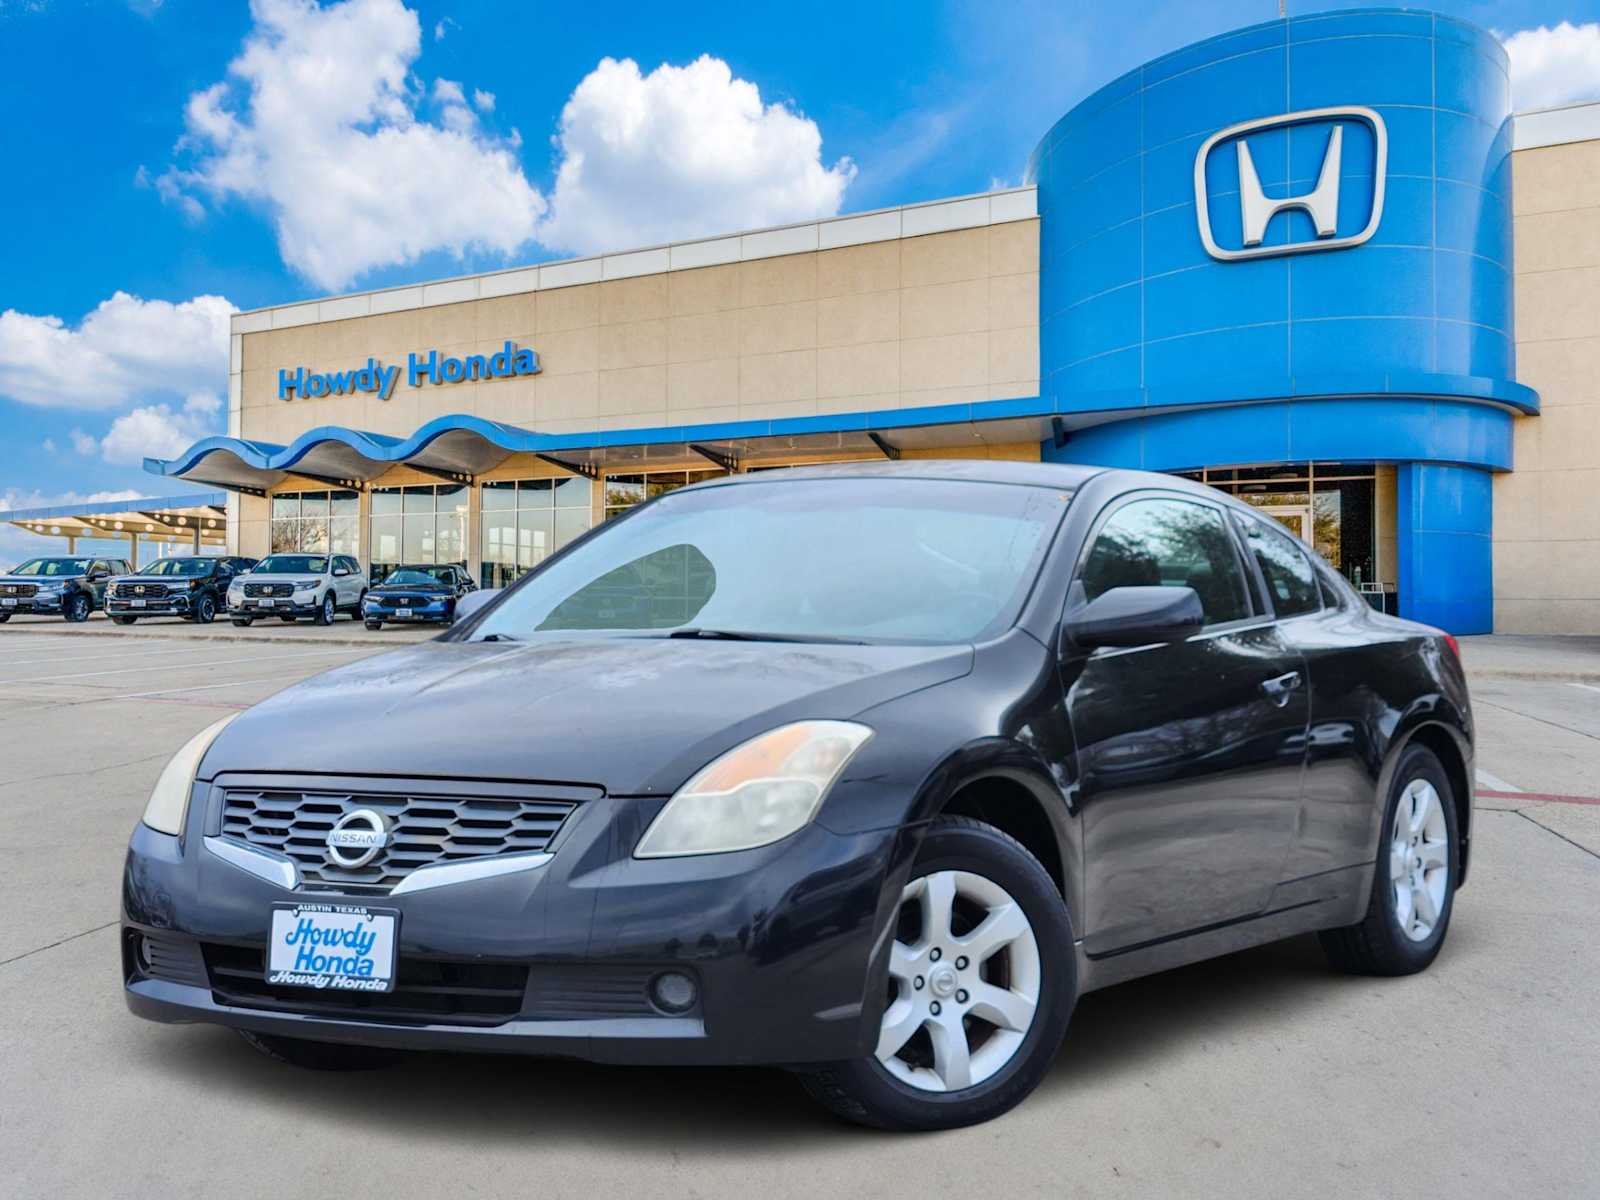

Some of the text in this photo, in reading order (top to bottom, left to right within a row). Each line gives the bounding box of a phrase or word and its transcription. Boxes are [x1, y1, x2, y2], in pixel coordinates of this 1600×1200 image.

[278, 341, 542, 401] Howdy Honda
[330, 832, 377, 844] NISSAN
[297, 904, 368, 914] AUSTIN TEXAS
[285, 918, 376, 955] Howdy
[295, 946, 374, 976] Honda
[270, 970, 388, 991] Howdy Honda
